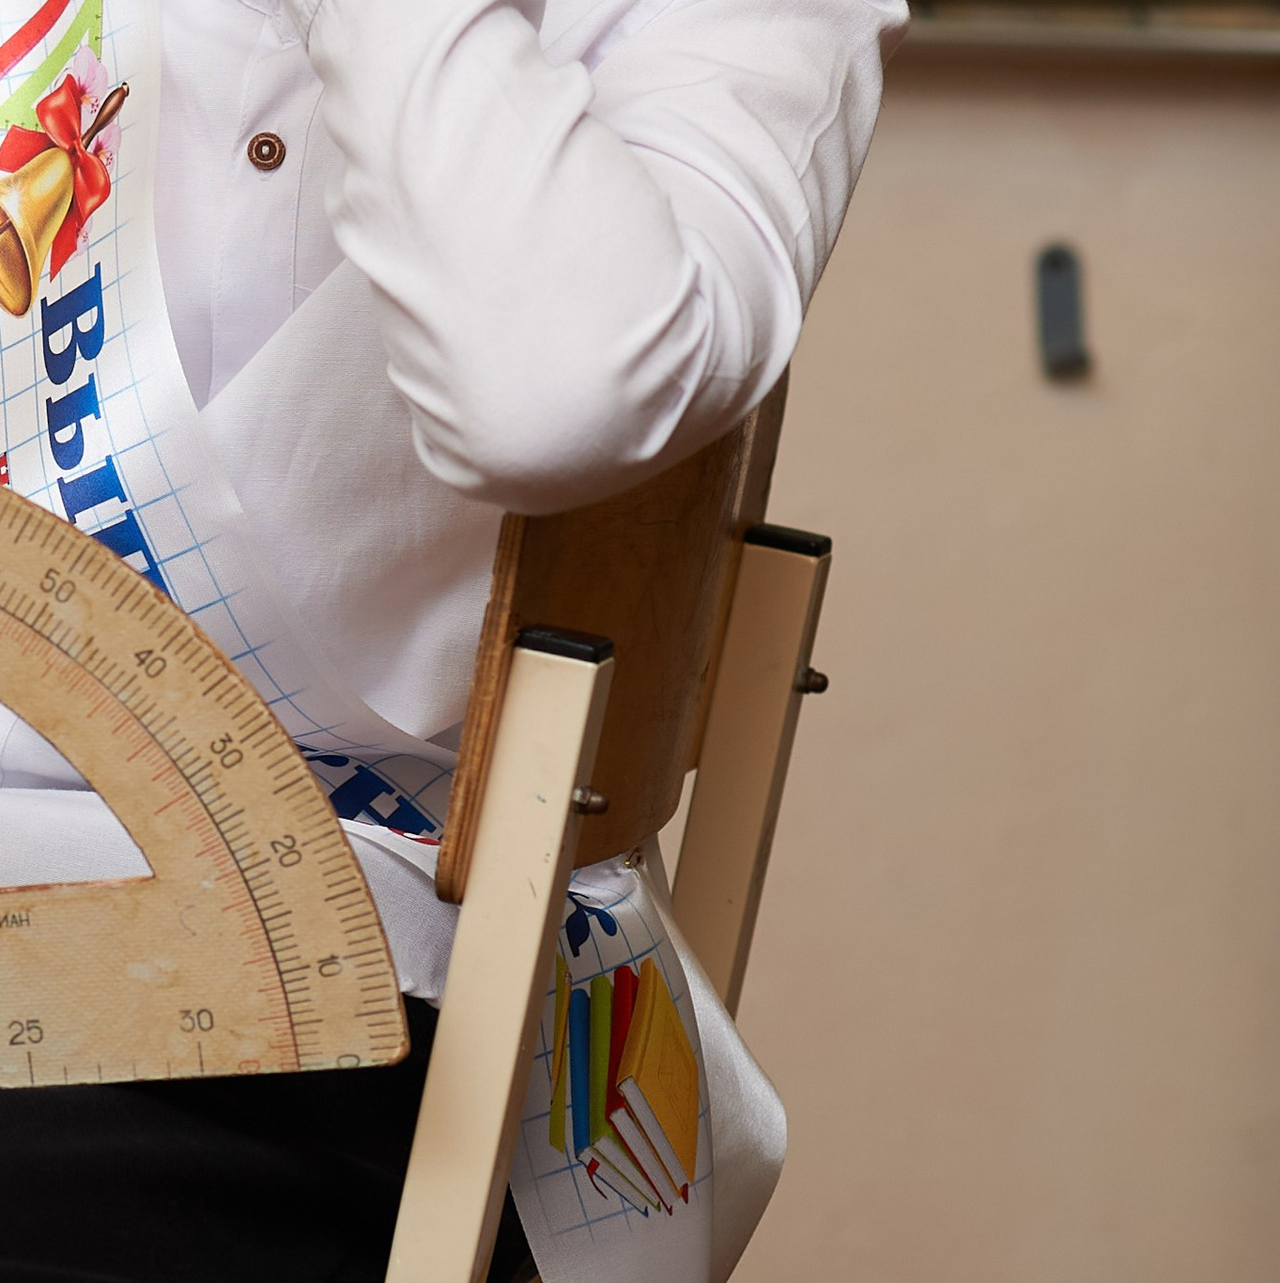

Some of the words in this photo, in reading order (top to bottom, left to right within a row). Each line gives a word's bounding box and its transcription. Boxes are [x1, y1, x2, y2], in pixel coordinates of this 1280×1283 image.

[39, 567, 77, 603] 50
[133, 649, 168, 679] 40
[210, 732, 244, 769] 30
[270, 834, 303, 868] 20
[317, 954, 343, 978] 10
[8, 1019, 44, 1046] 25
[178, 1008, 215, 1033] 30
